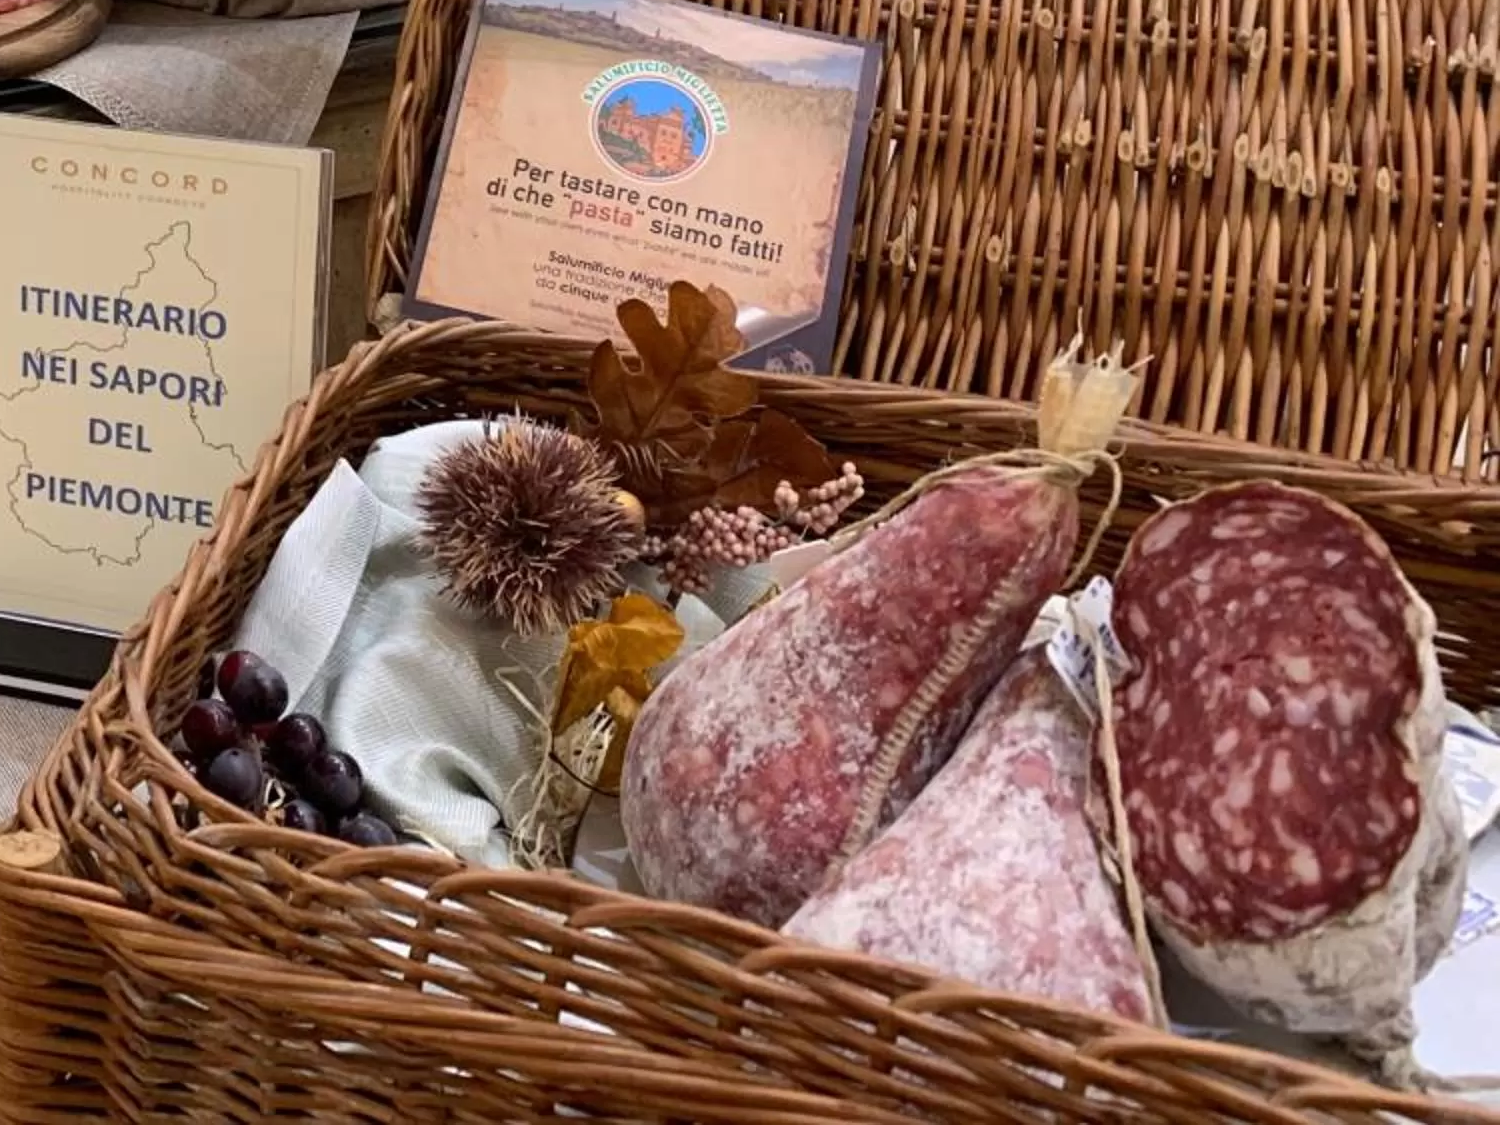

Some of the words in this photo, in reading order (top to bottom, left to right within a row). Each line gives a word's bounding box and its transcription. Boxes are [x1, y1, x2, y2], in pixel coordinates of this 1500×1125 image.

[583, 61, 670, 101] SALUMIFICIO
[30, 155, 229, 195] CONCORD
[513, 158, 554, 184] Per
[560, 170, 641, 206] tastare
[647, 194, 688, 217] con
[695, 206, 764, 235] mano
[486, 176, 509, 198] di
[513, 184, 555, 208] che
[649, 217, 723, 249] siamo
[731, 233, 784, 263] fatti!
[533, 262, 561, 278] una
[548, 250, 626, 279] Salumificio
[535, 277, 557, 291] da
[559, 282, 609, 305] cinque
[21, 285, 228, 340] ITINERARIO
[22, 350, 77, 385] NEI
[89, 361, 222, 407] SAPORI
[89, 417, 153, 453] DEL
[26, 472, 213, 528] PIEMONTE
